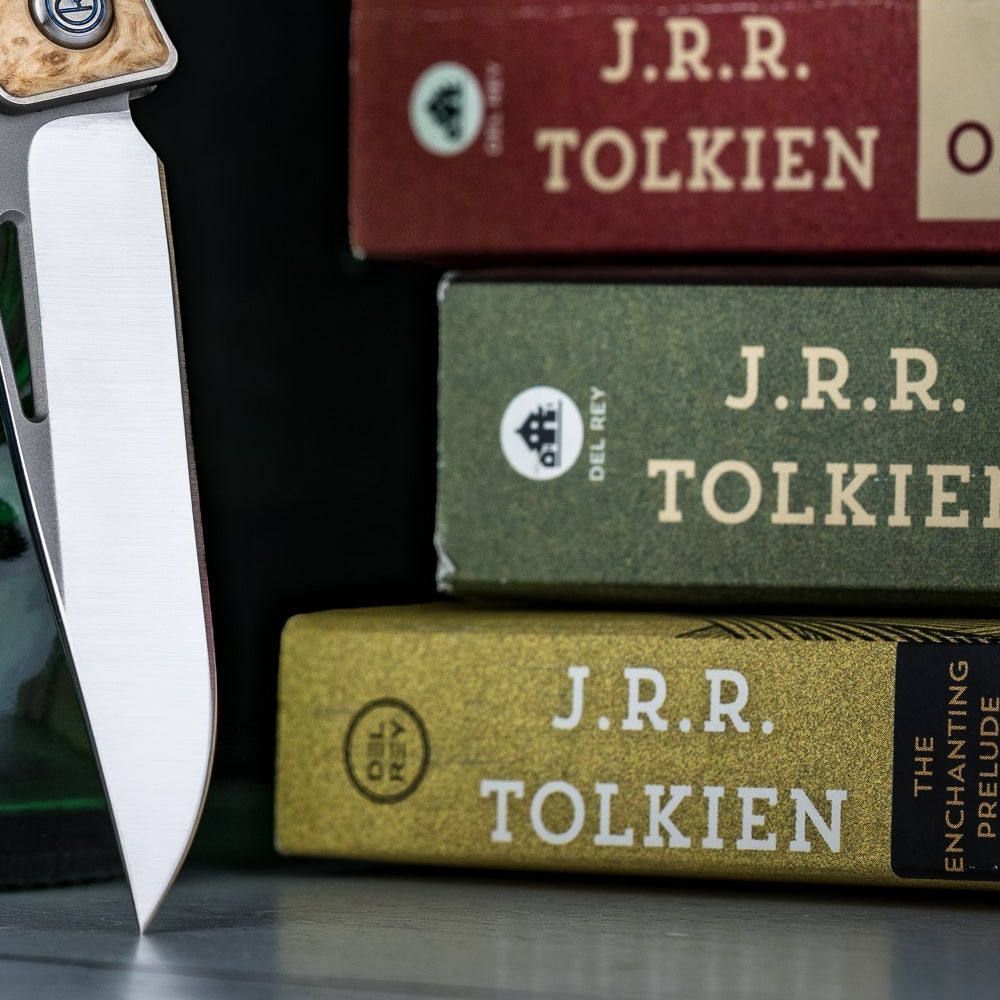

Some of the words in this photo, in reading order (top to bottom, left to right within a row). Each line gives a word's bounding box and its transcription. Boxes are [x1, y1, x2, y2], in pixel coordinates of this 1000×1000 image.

[600, 17, 810, 82] J.R.R.
[535, 127, 880, 193] TOLKIEN
[588, 386, 606, 432] REY
[724, 345, 966, 412] J.R.R.
[588, 439, 605, 482] DEL
[552, 666, 776, 736] J.R.R.
[914, 736, 935, 798] THE
[944, 660, 970, 874] ENCHANTING
[977, 696, 1000, 839] PRELUDE
[480, 779, 848, 854] TOLKIEN
